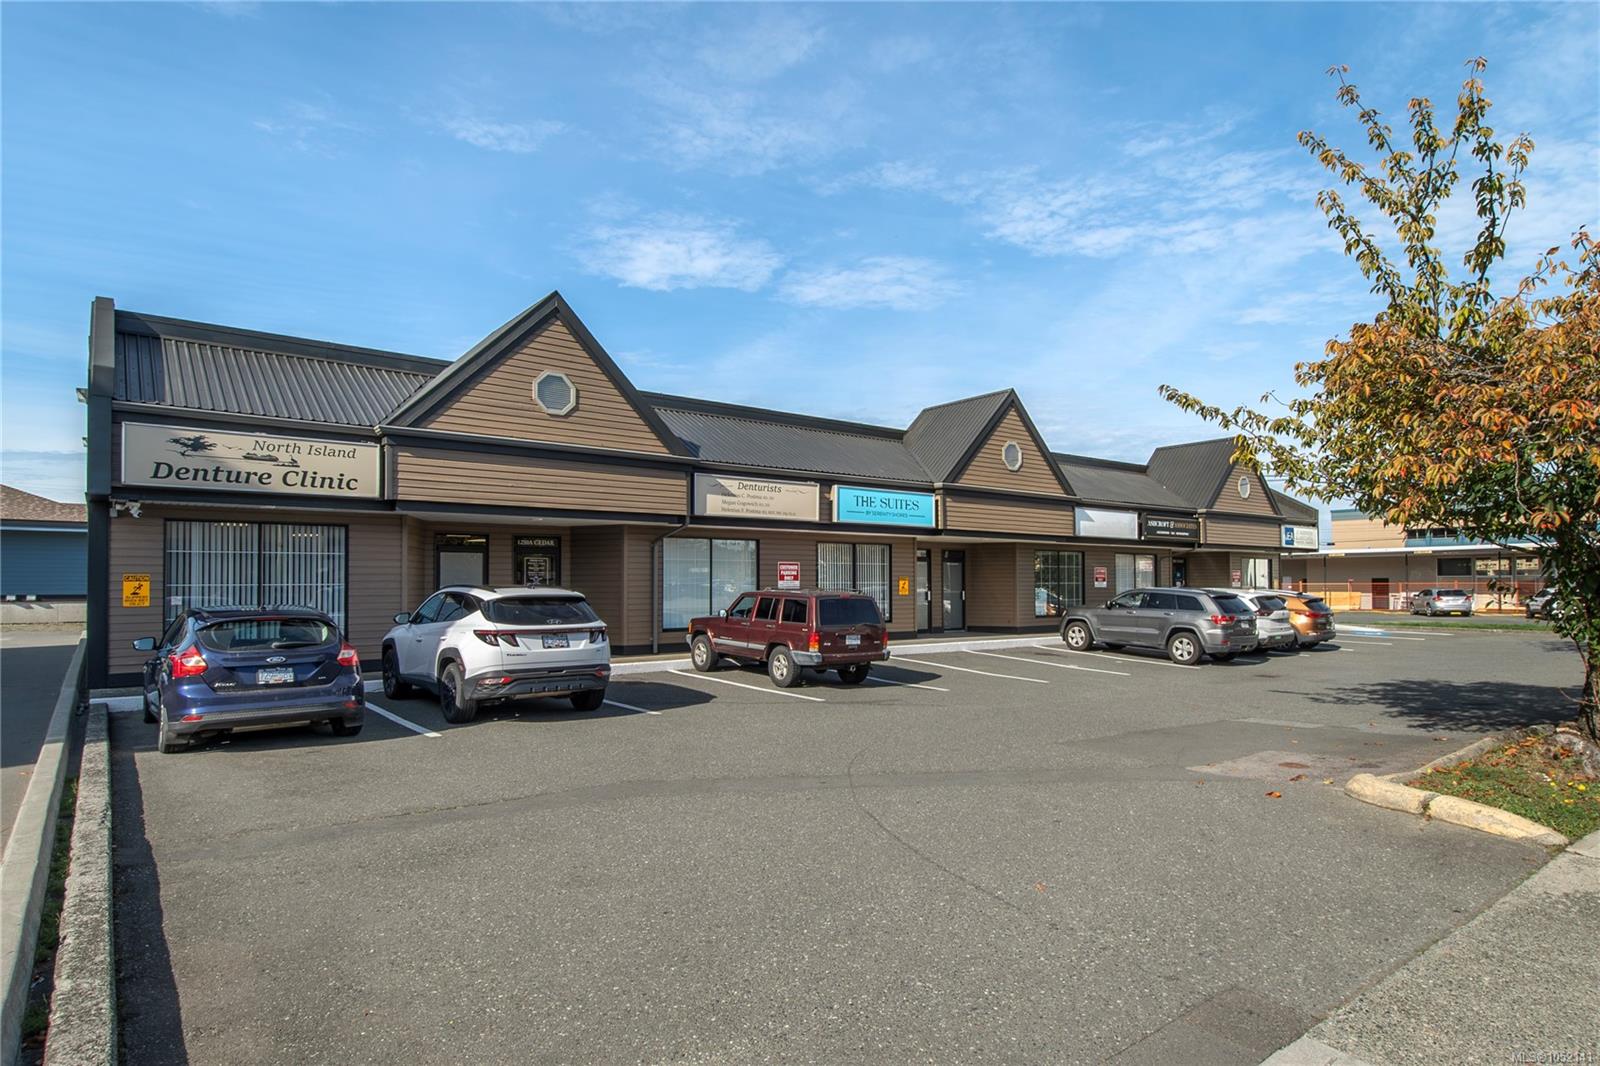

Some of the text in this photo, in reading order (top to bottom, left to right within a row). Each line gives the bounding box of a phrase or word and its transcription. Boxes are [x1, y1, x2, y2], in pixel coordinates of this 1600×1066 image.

[252, 439, 357, 459] North Island
[150, 461, 359, 491] Denture Clinic
[737, 481, 782, 494] Denturists
[853, 495, 920, 511] THE SUITES
